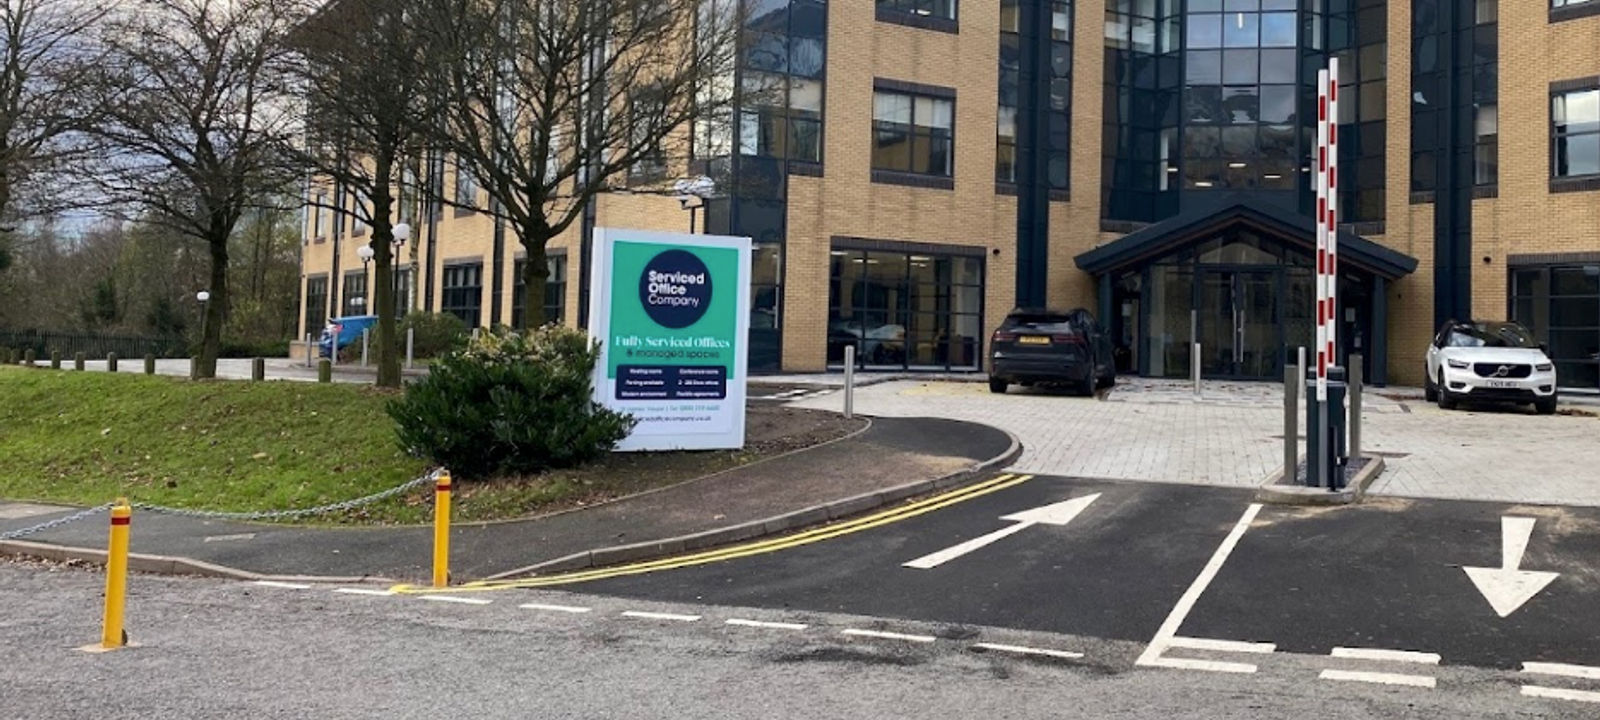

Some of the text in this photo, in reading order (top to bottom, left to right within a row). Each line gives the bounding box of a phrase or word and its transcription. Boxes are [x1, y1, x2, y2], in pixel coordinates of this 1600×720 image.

[648, 270, 704, 284] Serviced
[648, 283, 687, 295] Office
[648, 295, 700, 307] Company
[615, 336, 730, 349] Fully Serviced Offices
[636, 350, 684, 359] managed
[686, 351, 720, 359] spaces
